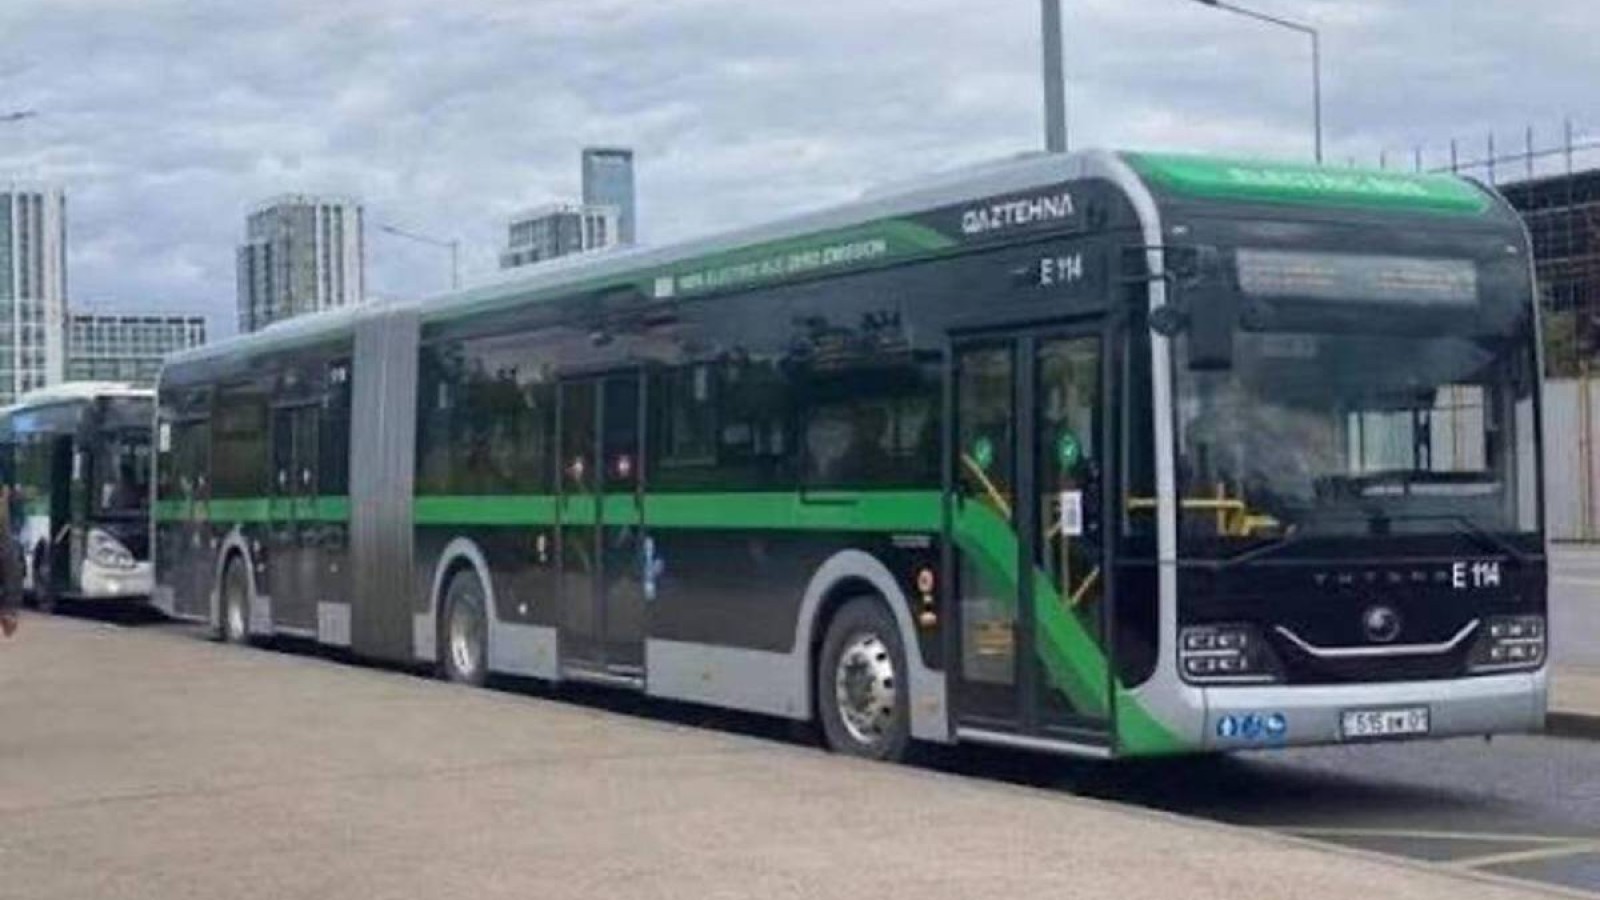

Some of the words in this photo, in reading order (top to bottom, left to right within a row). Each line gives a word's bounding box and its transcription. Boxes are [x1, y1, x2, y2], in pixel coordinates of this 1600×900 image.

[1040, 258, 1054, 286] E
[1452, 561, 1467, 588] E
[1472, 562, 1499, 588] 114
